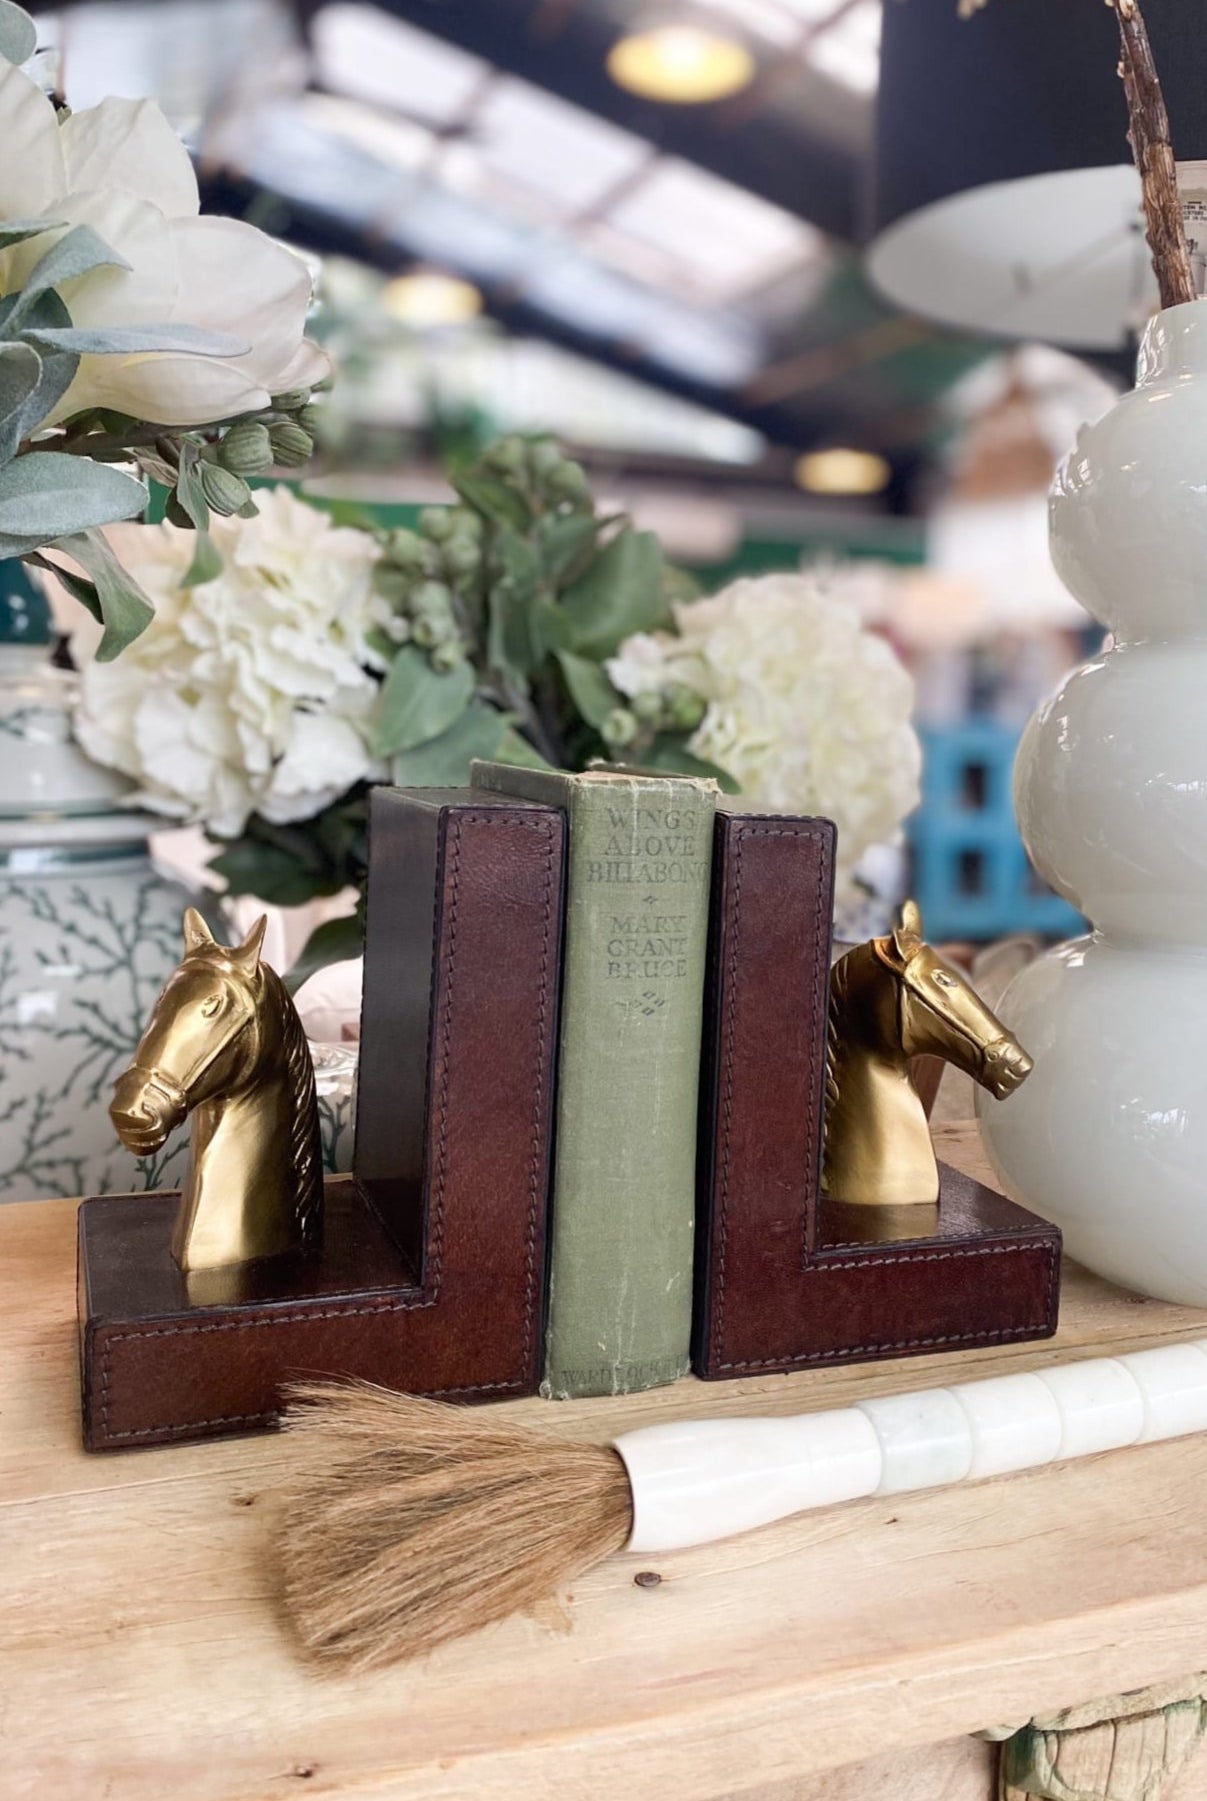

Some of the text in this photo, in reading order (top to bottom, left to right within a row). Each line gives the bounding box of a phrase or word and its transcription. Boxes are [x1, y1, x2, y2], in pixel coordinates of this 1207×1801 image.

[606, 807, 696, 830] WINGS
[602, 834, 695, 857] ABOVE
[610, 915, 688, 934] MARY
[606, 937, 688, 957] GRANT
[604, 959, 688, 979] BRUCE
